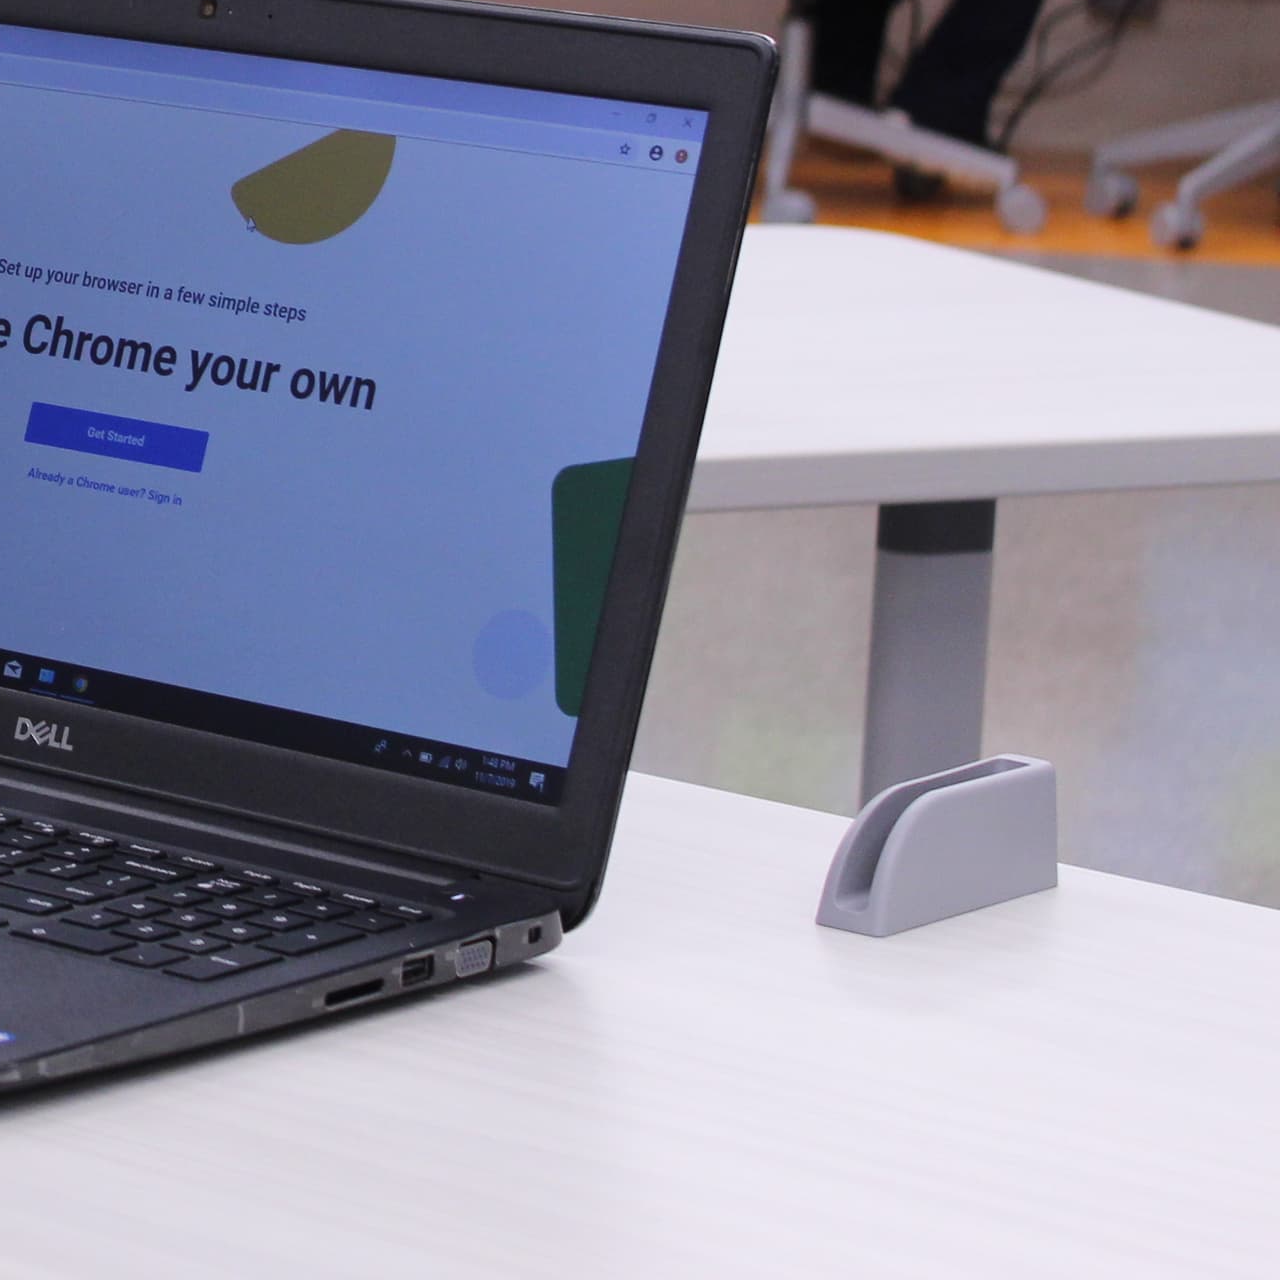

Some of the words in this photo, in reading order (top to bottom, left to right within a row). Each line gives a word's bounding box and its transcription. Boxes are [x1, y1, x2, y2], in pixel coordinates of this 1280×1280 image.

[24, 264, 43, 283] up
[45, 267, 80, 286] your
[82, 271, 143, 296] browser
[146, 281, 160, 298] in
[163, 287, 173, 300] a
[177, 285, 205, 305] few
[208, 291, 260, 316] simple
[263, 301, 307, 324] steps
[22, 314, 177, 377] Chrome
[185, 349, 280, 393] your
[289, 367, 377, 411] own
[87, 426, 105, 440] Get
[107, 430, 145, 447] Started
[28, 468, 65, 486] Already
[67, 477, 74, 486] a
[76, 477, 115, 494] Chrome
[117, 487, 146, 499] user?
[148, 489, 170, 505] Sign
[172, 494, 182, 506] in
[14, 716, 73, 751] DELL
